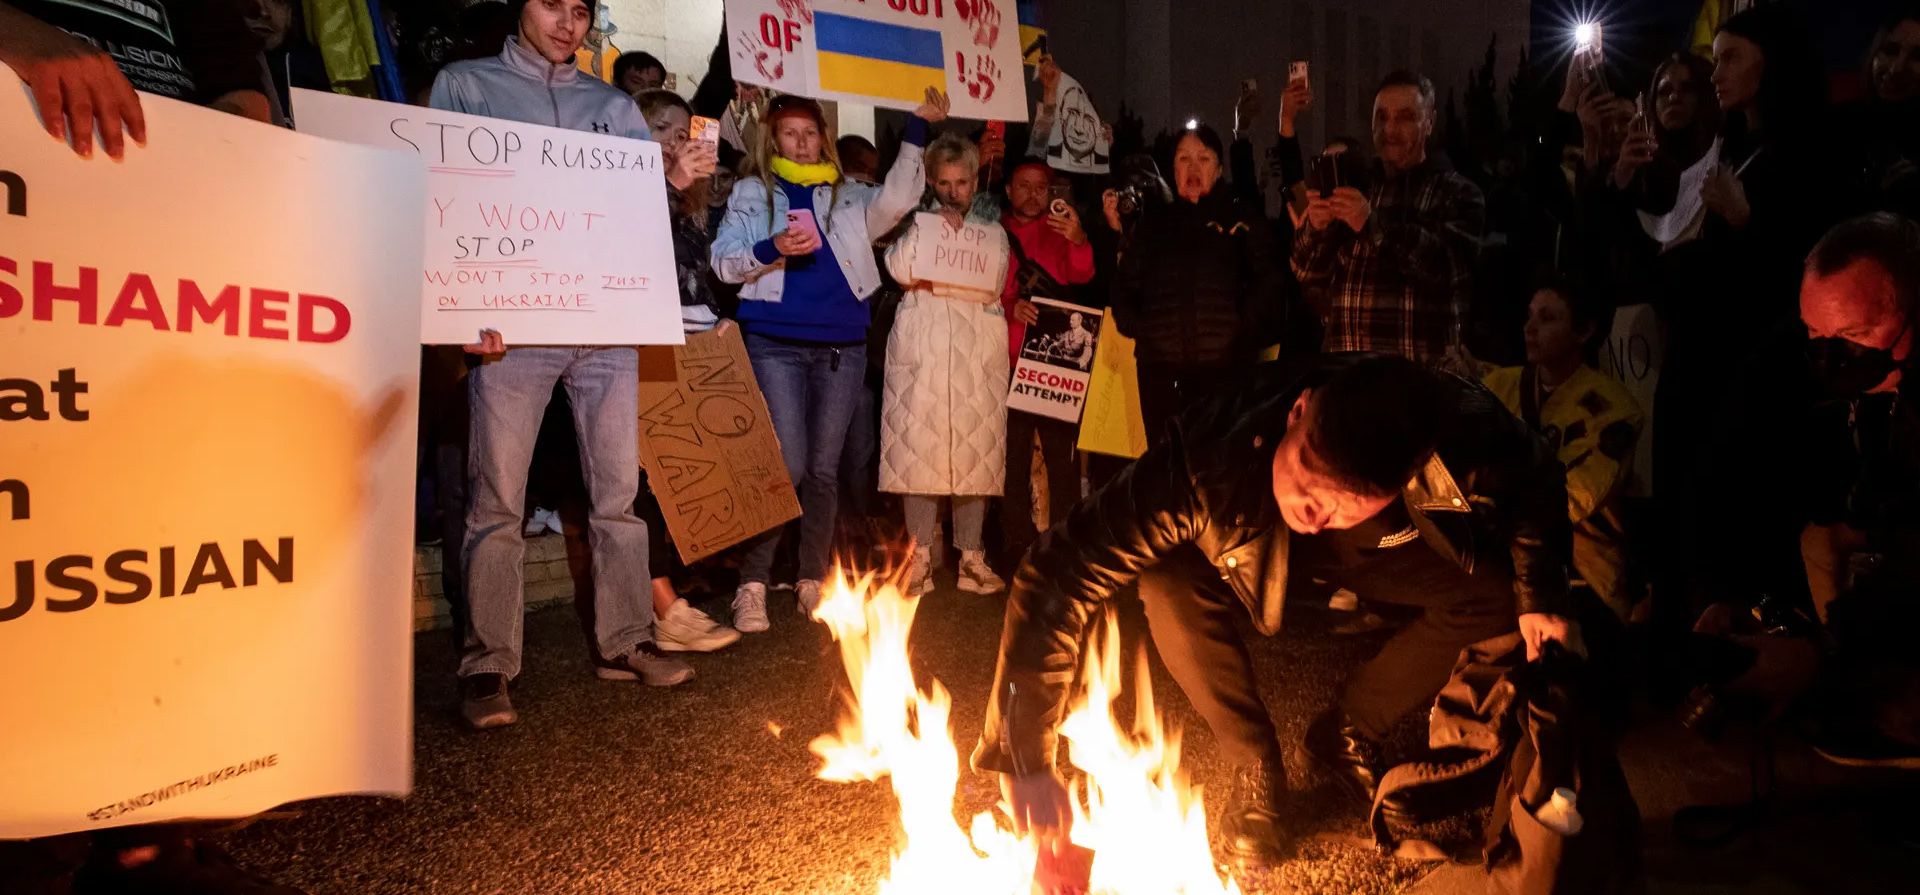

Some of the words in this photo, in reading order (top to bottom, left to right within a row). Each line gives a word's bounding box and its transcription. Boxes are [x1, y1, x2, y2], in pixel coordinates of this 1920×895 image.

[760, 13, 801, 52] OF
[390, 118, 522, 165] STOP
[541, 139, 655, 173] RUSSIA!
[478, 202, 606, 232] WON'T
[454, 235, 535, 260] STOP
[935, 244, 989, 275] PUTIN
[530, 272, 585, 287] STOP
[602, 275, 650, 287] JUST
[438, 296, 459, 307] ON
[483, 293, 594, 308] UKRAINE
[1607, 333, 1650, 384] NO
[1013, 382, 1082, 408] ATTEMPT
[1016, 366, 1085, 393] SECOND
[680, 354, 756, 439] NO
[638, 387, 746, 553] WAR!
[86, 753, 279, 822] #STANDWITHUKRAINE
